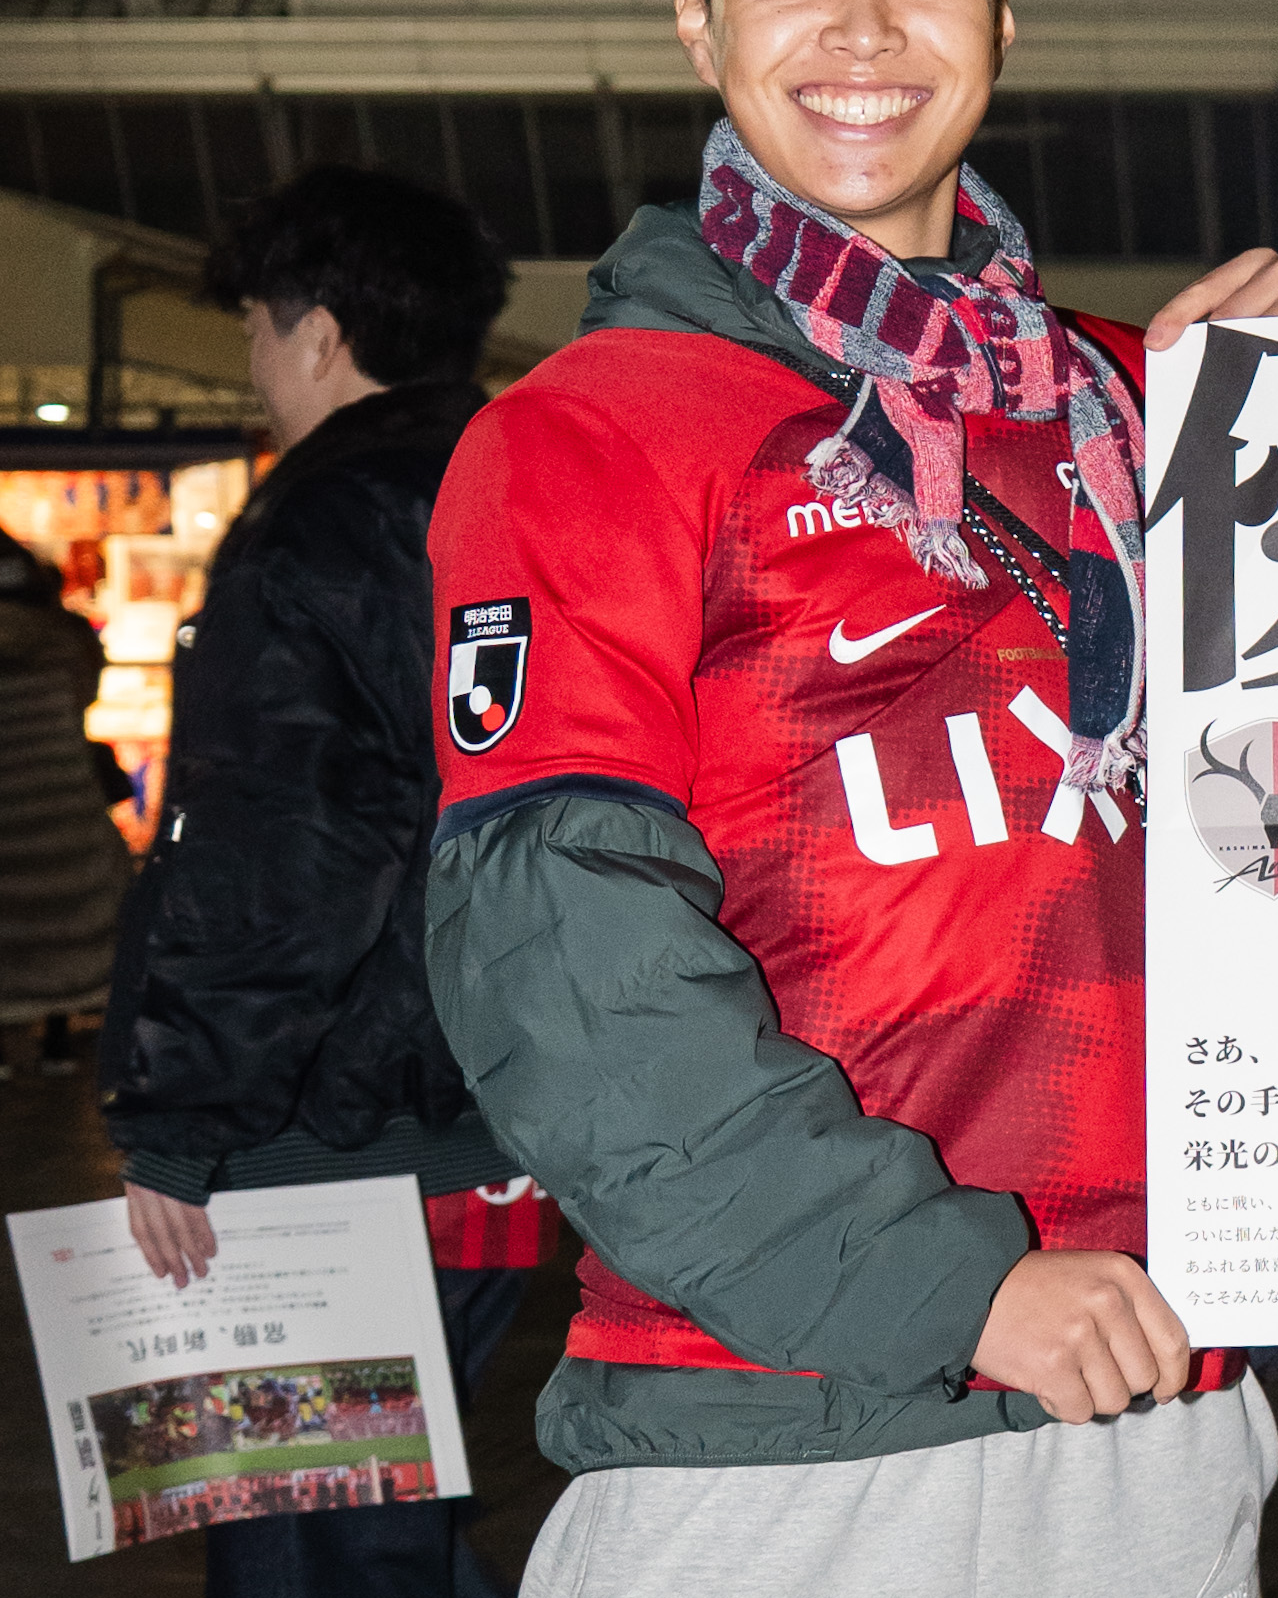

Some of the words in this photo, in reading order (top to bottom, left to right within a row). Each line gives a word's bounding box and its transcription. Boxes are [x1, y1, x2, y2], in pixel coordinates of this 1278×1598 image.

[463, 605, 513, 626] 明治安田
[1219, 844, 1266, 852] KASHIMA
[1185, 1034, 1259, 1065] さあ、
[1185, 1195, 1273, 1212] ともに戦い、
